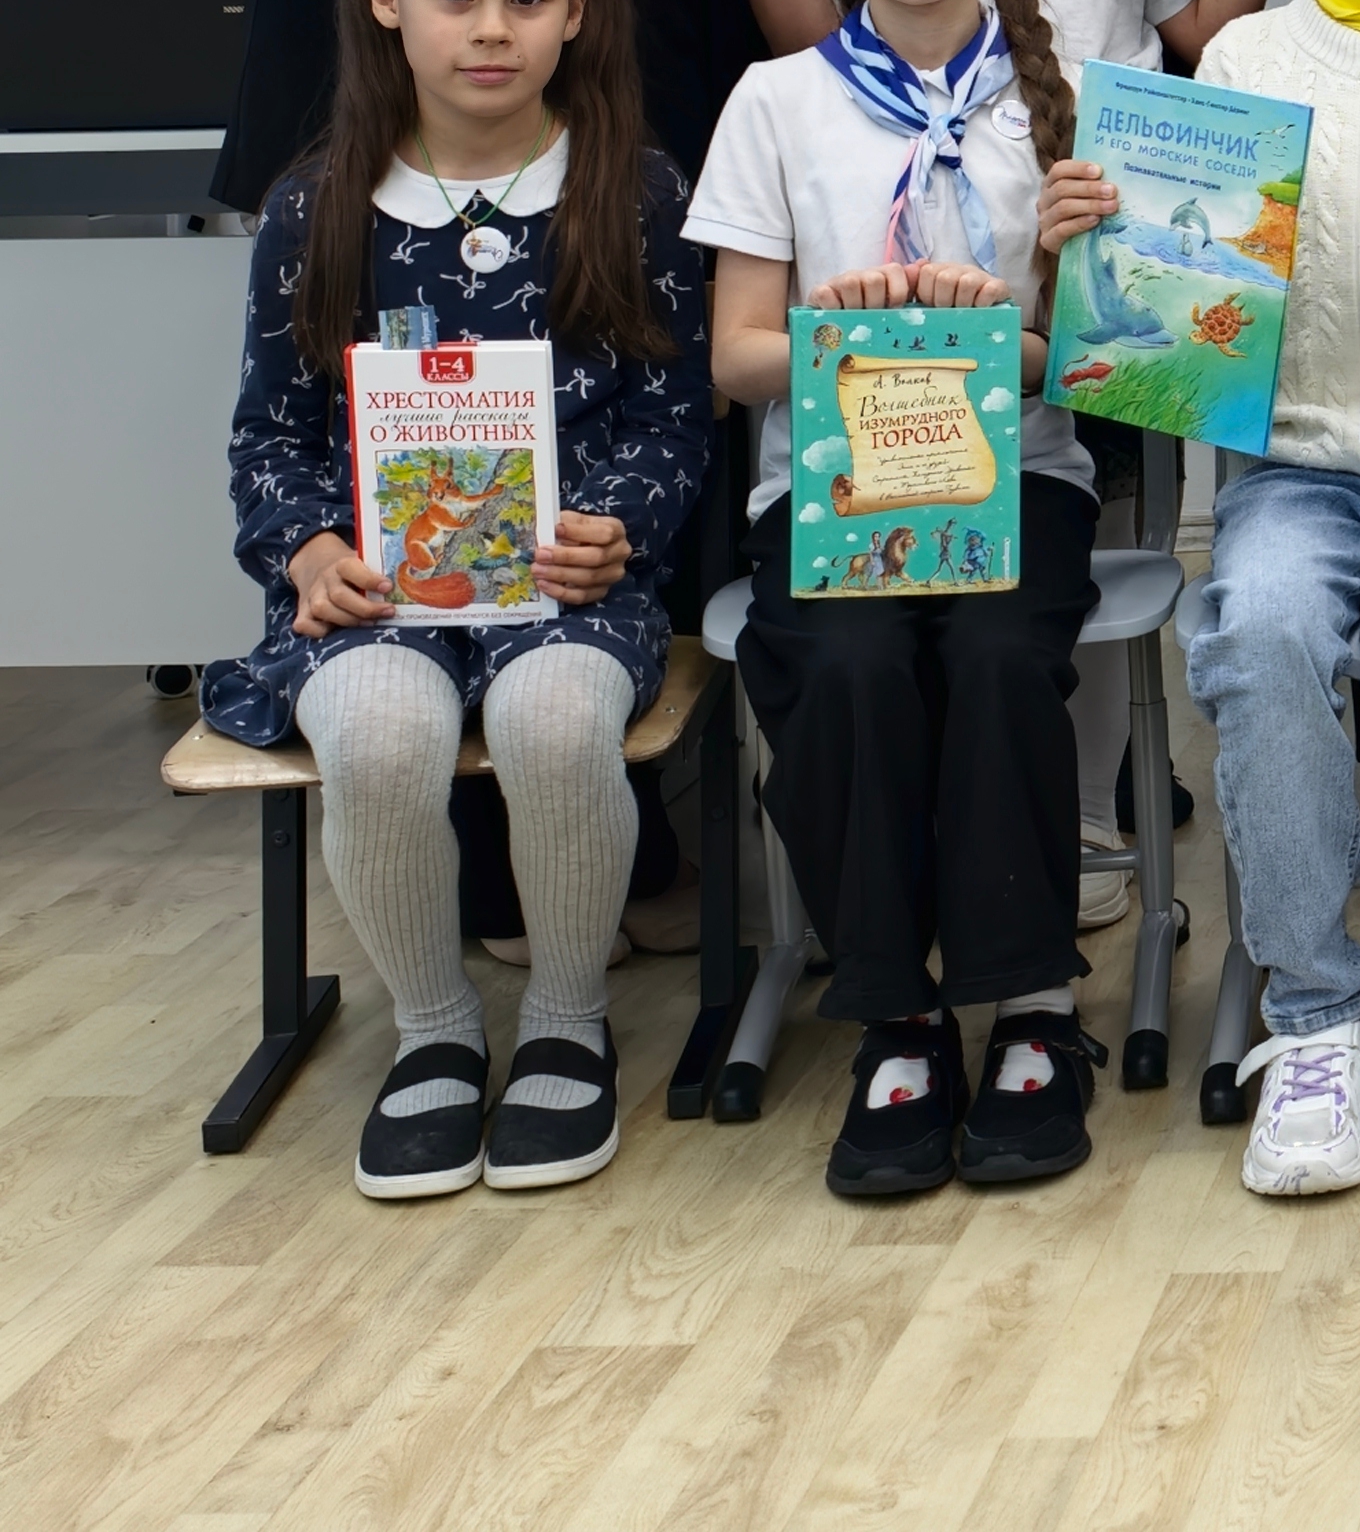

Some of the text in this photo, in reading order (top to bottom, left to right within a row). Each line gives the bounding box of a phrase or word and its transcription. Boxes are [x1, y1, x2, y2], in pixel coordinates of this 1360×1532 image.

[1097, 107, 1259, 162] ДЕЛЬФИНЧИК
[1095, 134, 1257, 179] И ЕГО МОРСКИЕ СОСЕДИ
[1123, 161, 1222, 191] Познавательные истории
[426, 372, 470, 382] КЛАССЫ
[874, 372, 932, 388] А. Волков
[366, 391, 536, 409] ХРЕСТОМАТИЯ
[860, 385, 961, 418] Волшебник
[379, 409, 530, 428] лучшие рассказы
[860, 408, 967, 431] ИЗУМРУДНОГО
[370, 423, 537, 442] О ЖИВОТНЫХ
[871, 423, 963, 450] ГОРОДА
